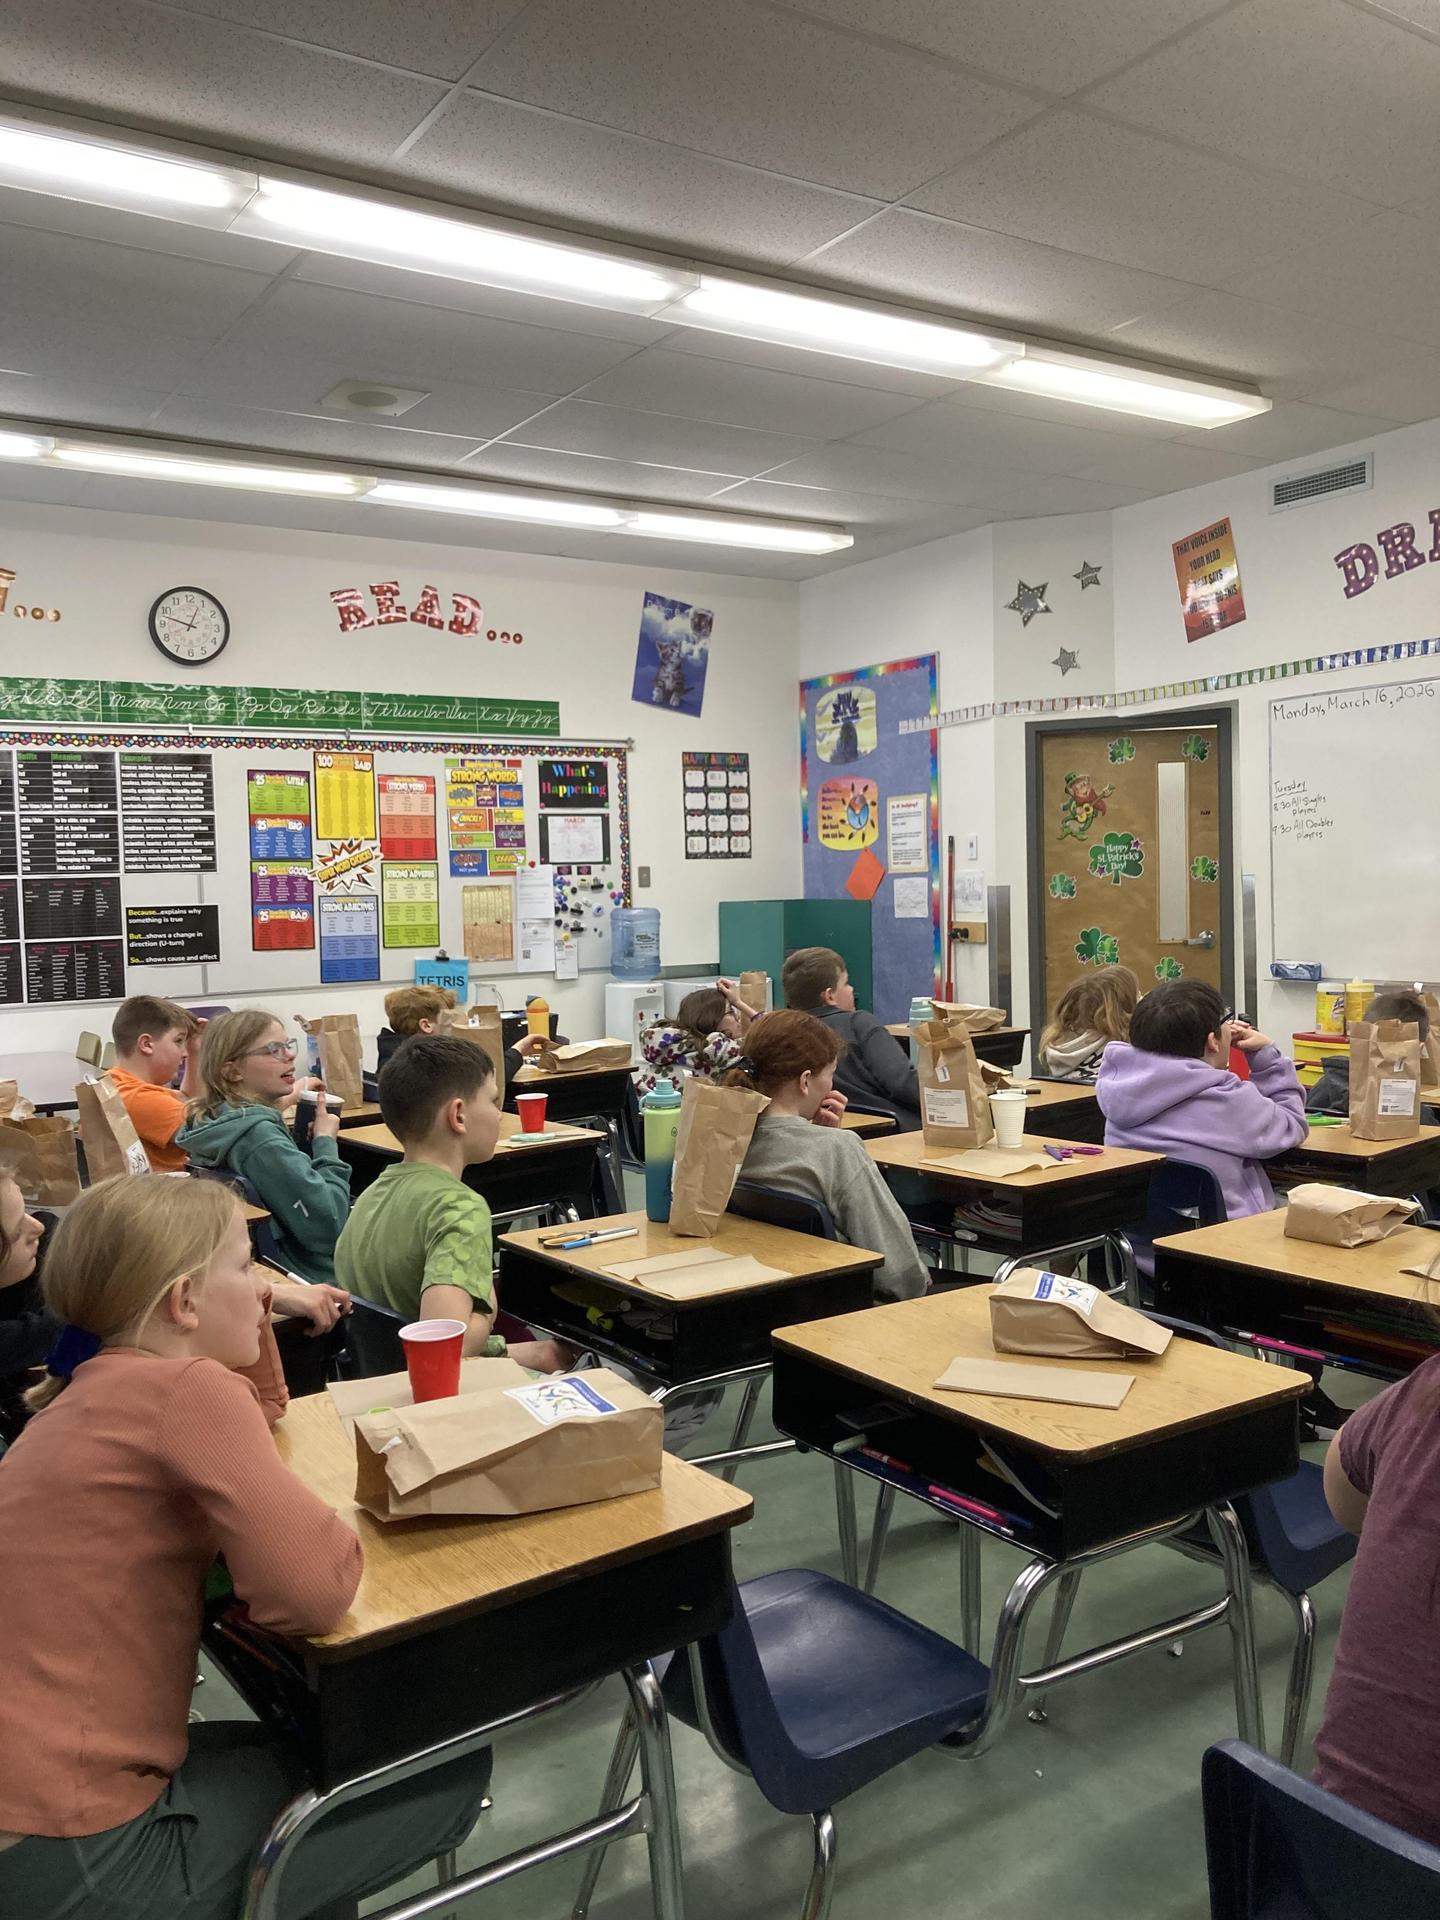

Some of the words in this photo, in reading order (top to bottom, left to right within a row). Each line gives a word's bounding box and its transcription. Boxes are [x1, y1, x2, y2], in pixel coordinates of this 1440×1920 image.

[1176, 541, 1190, 556] THAT
[1190, 533, 1208, 551] VOICE
[1207, 523, 1229, 542] INSIDE
[1189, 555, 1206, 572] YOUR
[1206, 548, 1221, 565] HEAD
[1208, 569, 1224, 585] SAYS
[172, 597, 180, 605] 11
[185, 594, 195, 604] 12
[201, 600, 205, 608] 1
[161, 606, 172, 615] 10
[210, 610, 216, 619] 2
[159, 620, 166, 628] 9
[214, 624, 221, 633] 3
[163, 633, 170, 642] 8
[211, 637, 217, 645] 4
[174, 644, 180, 653] 7
[188, 648, 195, 657] 6
[201, 646, 207, 655] 5
[1273, 702, 1326, 720] Monday,
[1327, 691, 1371, 710] March
[1395, 682, 1435, 702] 2026
[108, 692, 158, 709] Mm
[158, 693, 199, 711] Nn
[241, 696, 269, 718] Pp
[478, 705, 507, 722] Xx
[505, 707, 536, 728] Yy
[317, 755, 333, 768] 100
[354, 760, 372, 771] SAID
[552, 764, 596, 777] What's
[451, 769, 486, 783] STRONG
[486, 770, 518, 784] WORDS
[541, 782, 607, 798] Happening
[1273, 779, 1307, 794] Tuesday
[1106, 843, 1129, 854] Happy
[1107, 852, 1140, 863] Patrick's
[288, 866, 309, 877] GOOD
[1110, 861, 1127, 871] Day!
[188, 907, 202, 915] why
[289, 910, 308, 921] BAD
[129, 940, 158, 948] direction
[159, 940, 185, 948] (U-turn)
[419, 975, 465, 987] TETRIS
